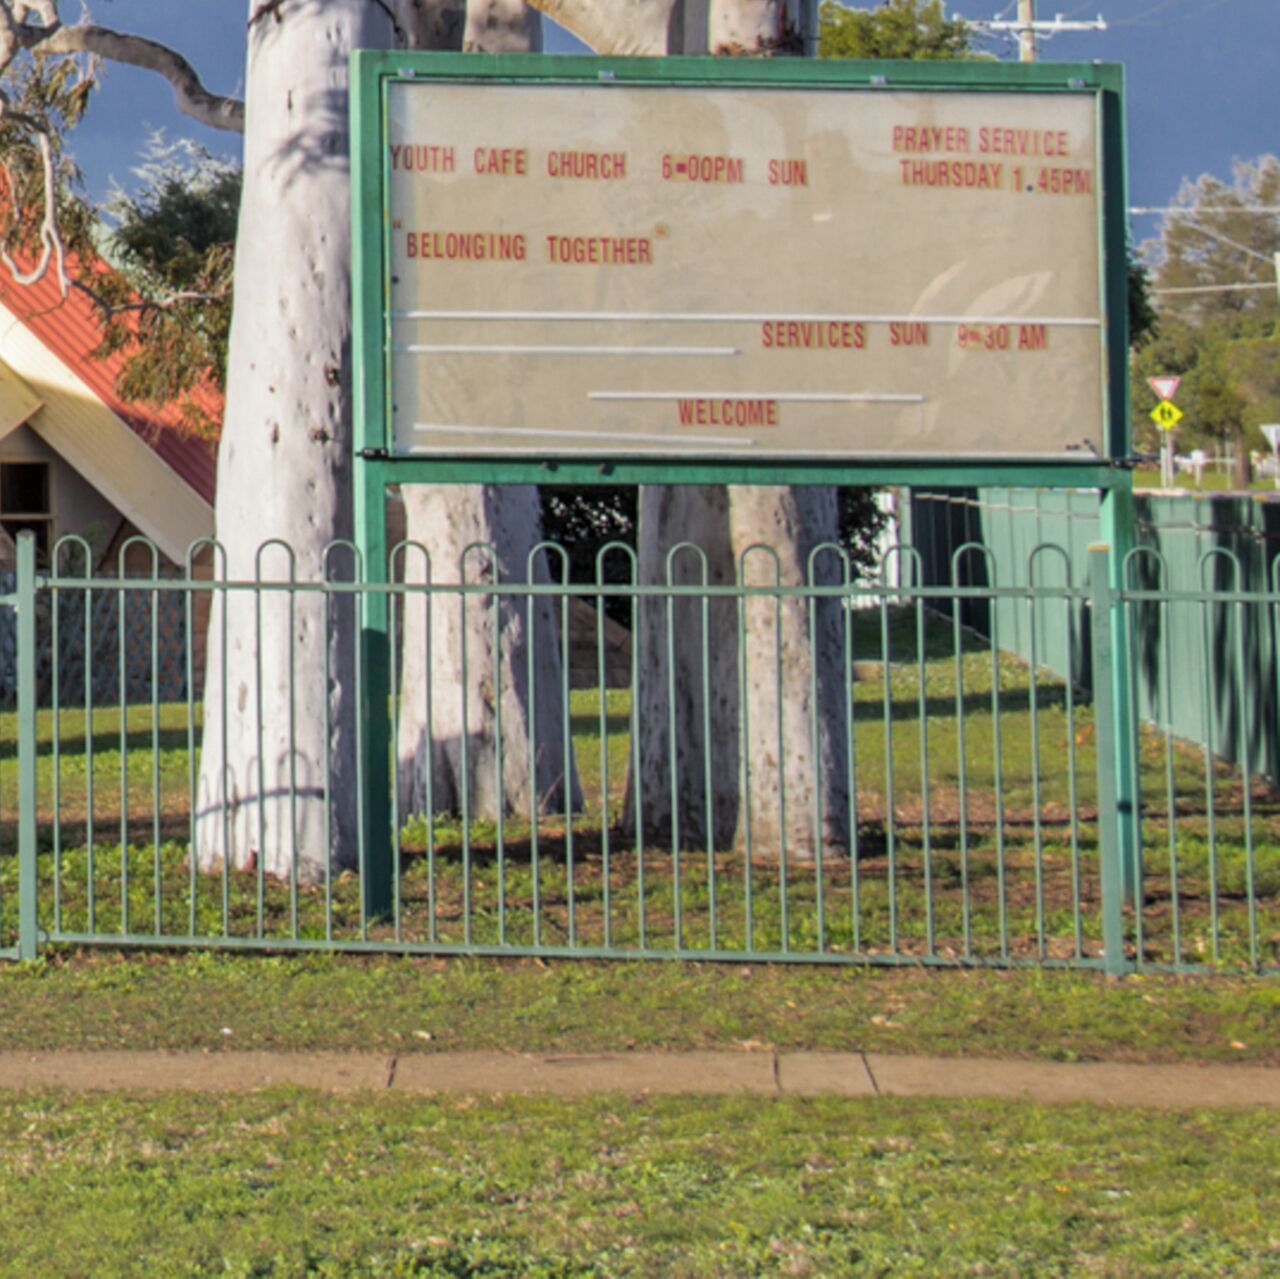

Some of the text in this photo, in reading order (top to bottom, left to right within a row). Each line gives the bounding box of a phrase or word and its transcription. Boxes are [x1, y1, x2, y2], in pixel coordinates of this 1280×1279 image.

[892, 125, 1069, 156] PRAYER SERVICE
[389, 144, 454, 171] YOUTH
[473, 147, 526, 175] CAFE
[547, 151, 626, 179] CHURCH
[767, 159, 807, 186] SUN
[900, 159, 1003, 189] THURSDAY
[761, 321, 866, 349] SERVICES
[889, 321, 929, 346] SUN
[1018, 323, 1048, 350] AM
[677, 399, 777, 426] WELCOME
